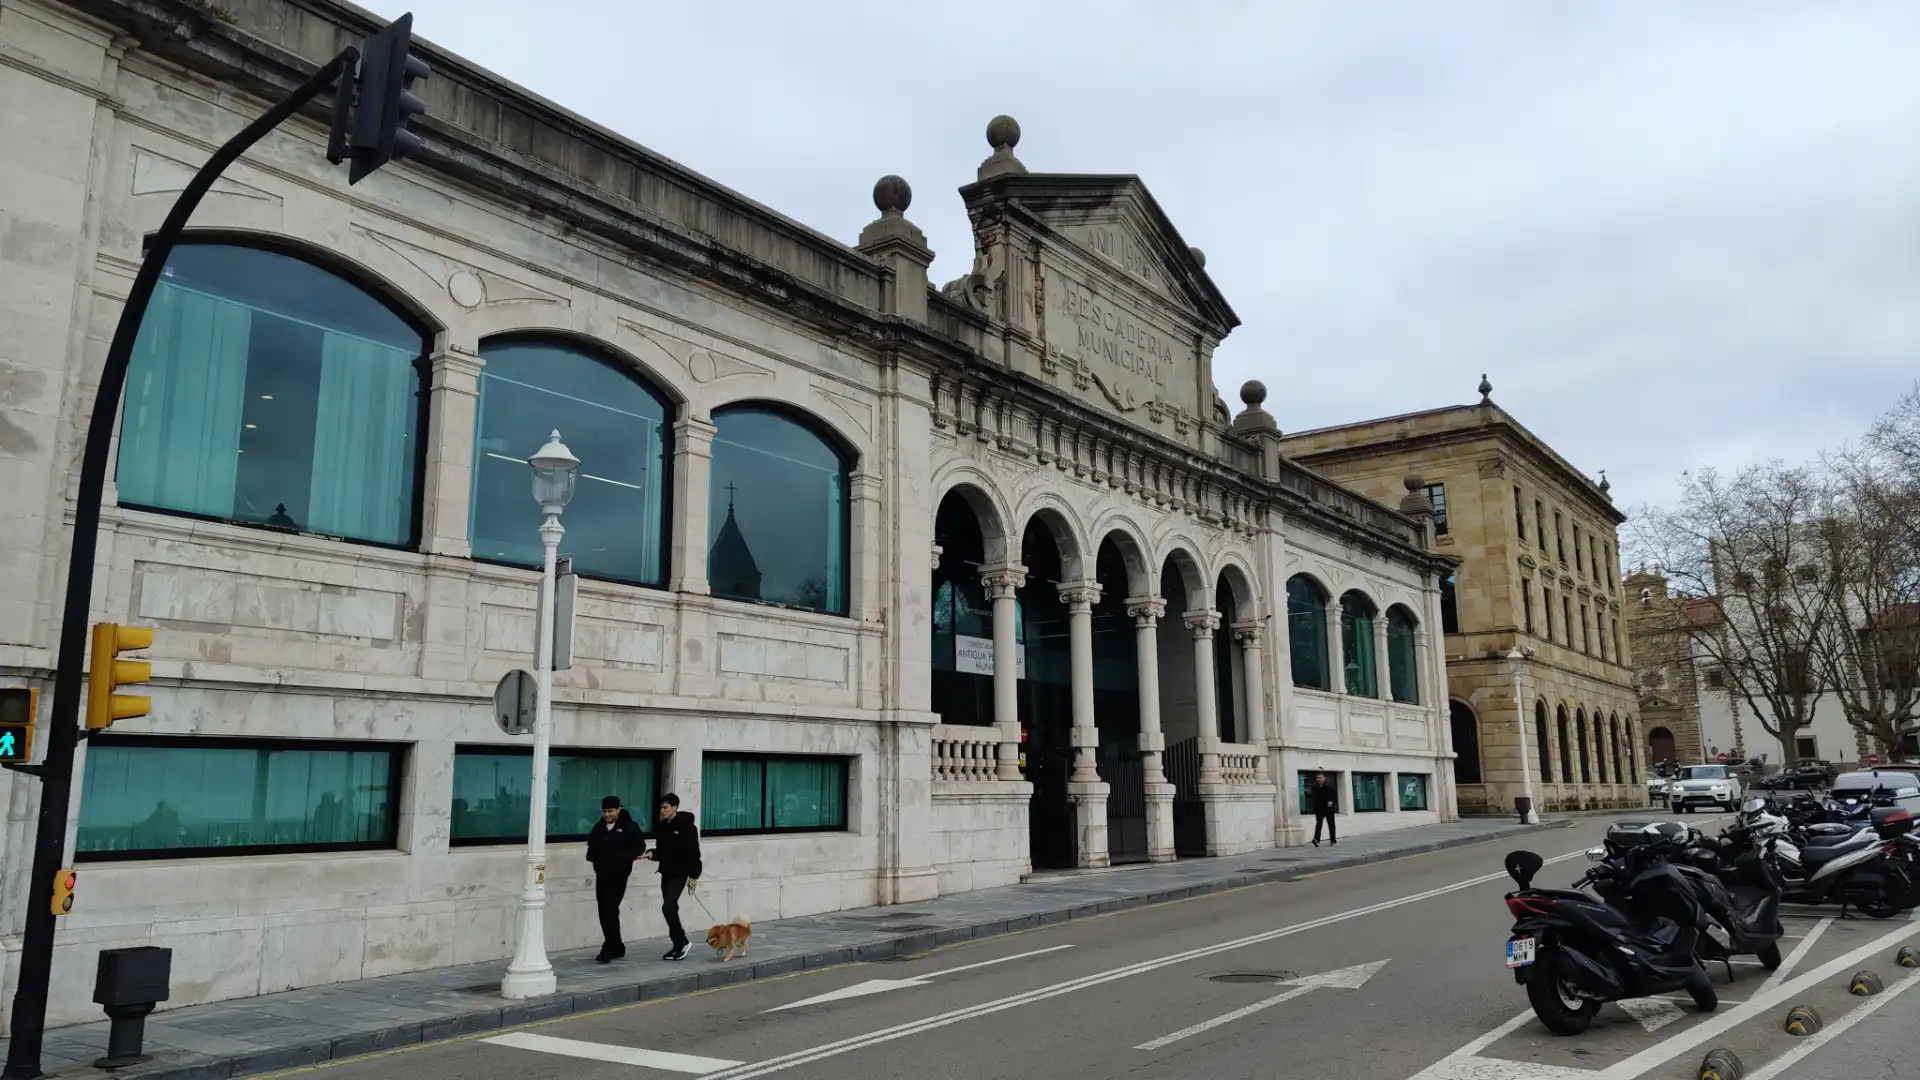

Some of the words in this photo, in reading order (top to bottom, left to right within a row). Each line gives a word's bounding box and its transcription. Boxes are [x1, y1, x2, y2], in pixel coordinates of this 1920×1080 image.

[1065, 288, 1173, 365] PESCADERIA
[1078, 325, 1164, 386] MUNICIPAL
[957, 649, 986, 660] ANTIGUA
[1513, 940, 1534, 952] 0619
